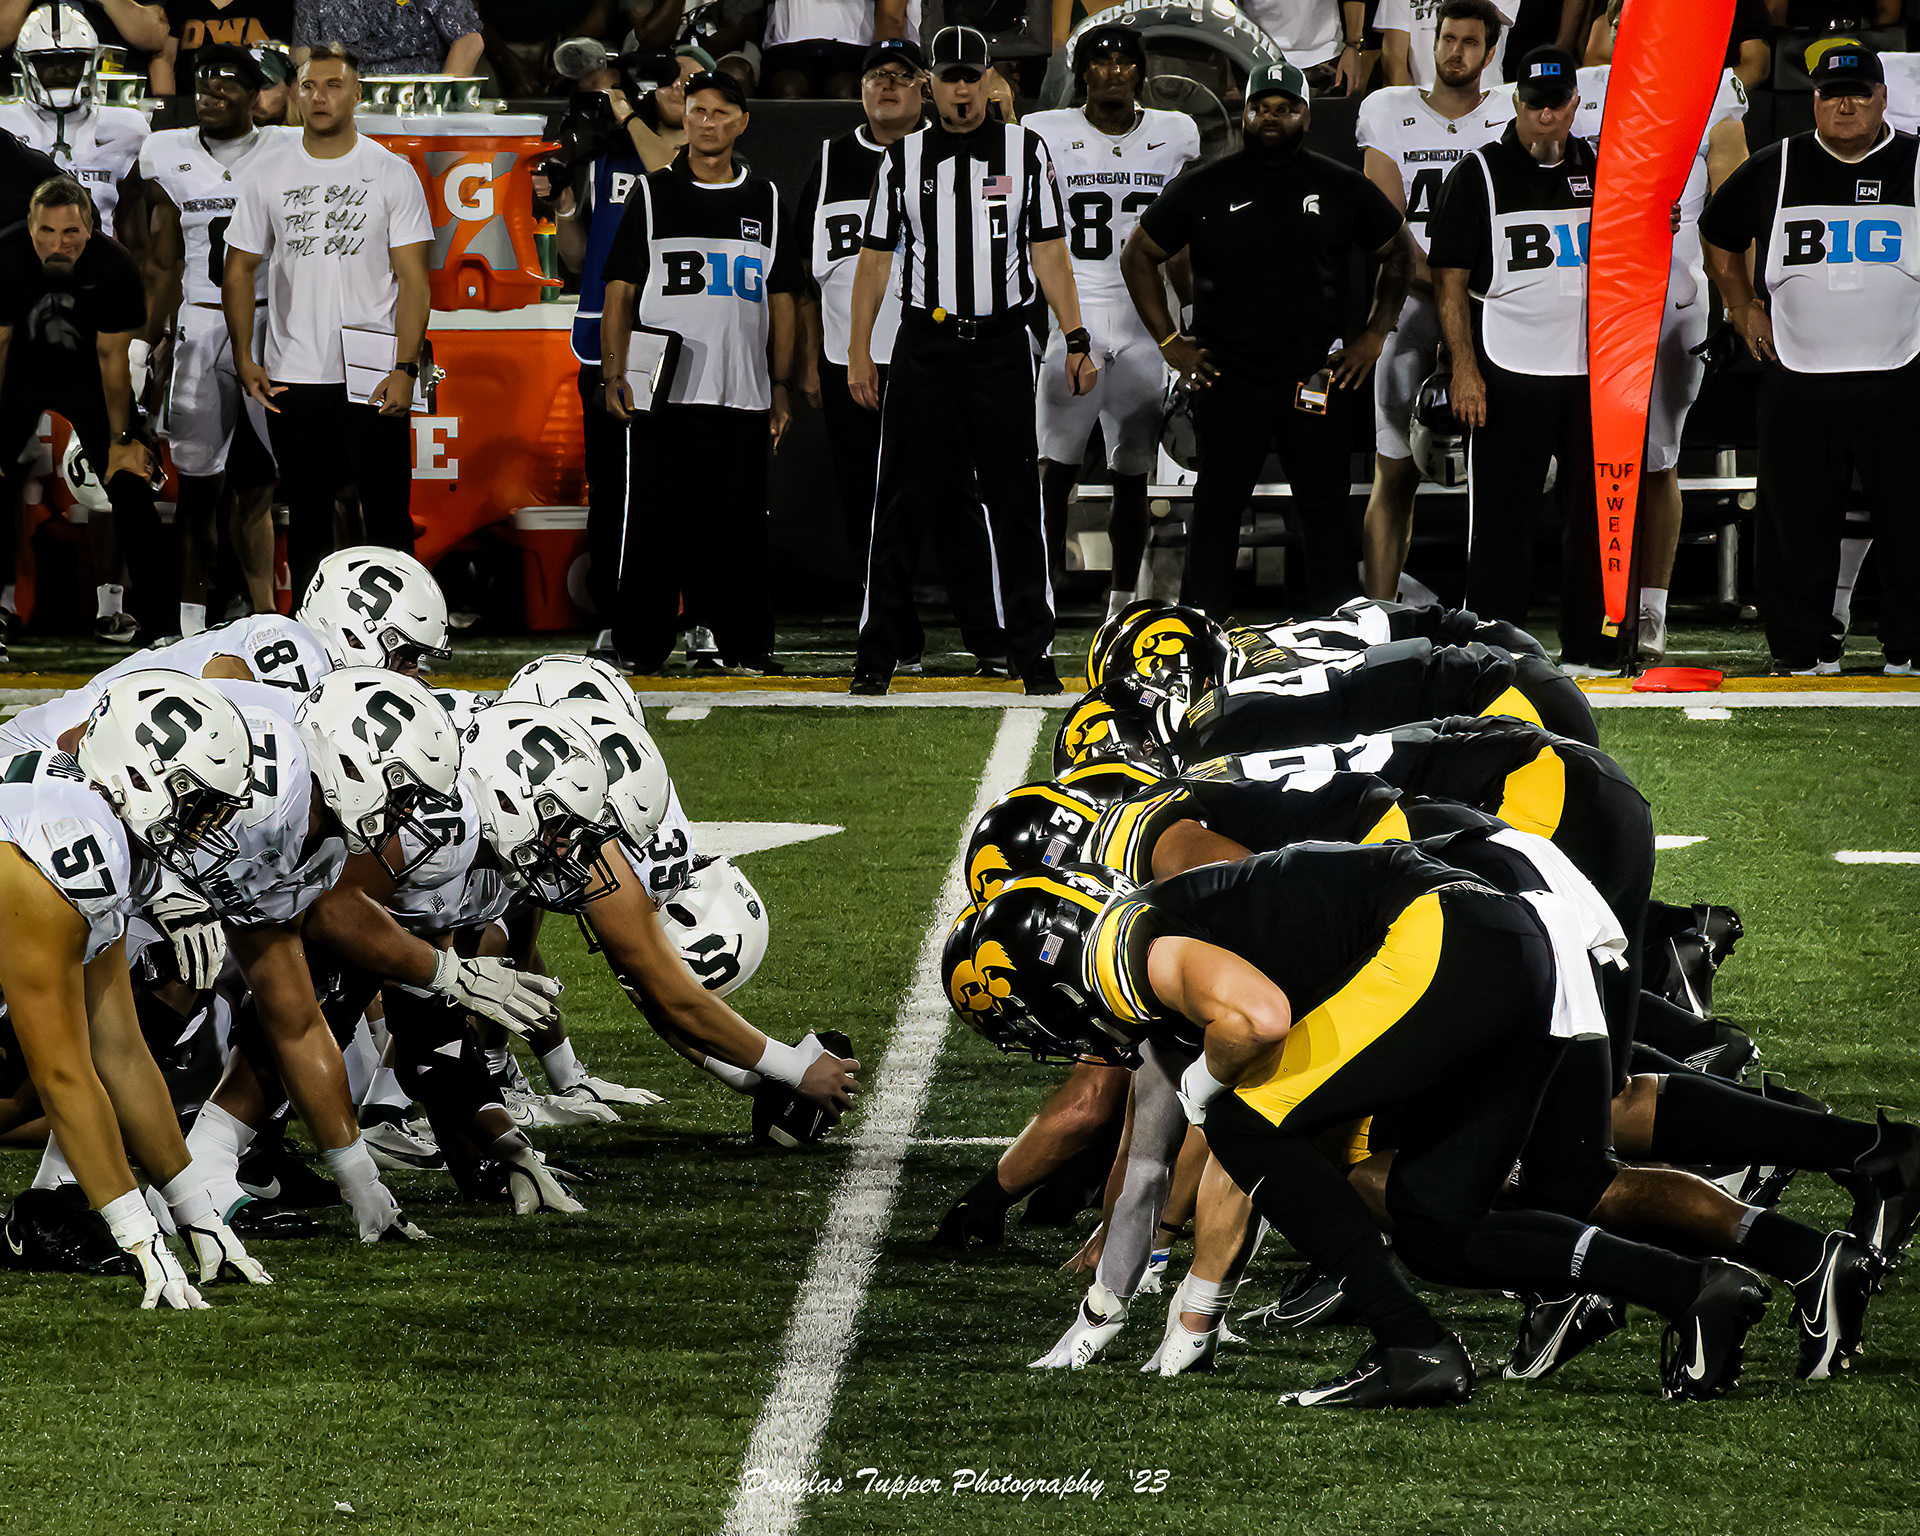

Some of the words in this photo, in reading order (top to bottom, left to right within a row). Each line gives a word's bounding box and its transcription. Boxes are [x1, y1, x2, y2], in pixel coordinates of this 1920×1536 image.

[181, 17, 270, 51] OWA
[444, 162, 494, 221] G
[991, 218, 1007, 239] L
[411, 416, 459, 480] E
[346, 565, 404, 622] S
[253, 639, 311, 693] 87
[135, 696, 203, 762] S
[351, 690, 416, 753] S
[505, 725, 570, 786] S
[50, 833, 118, 900] 57
